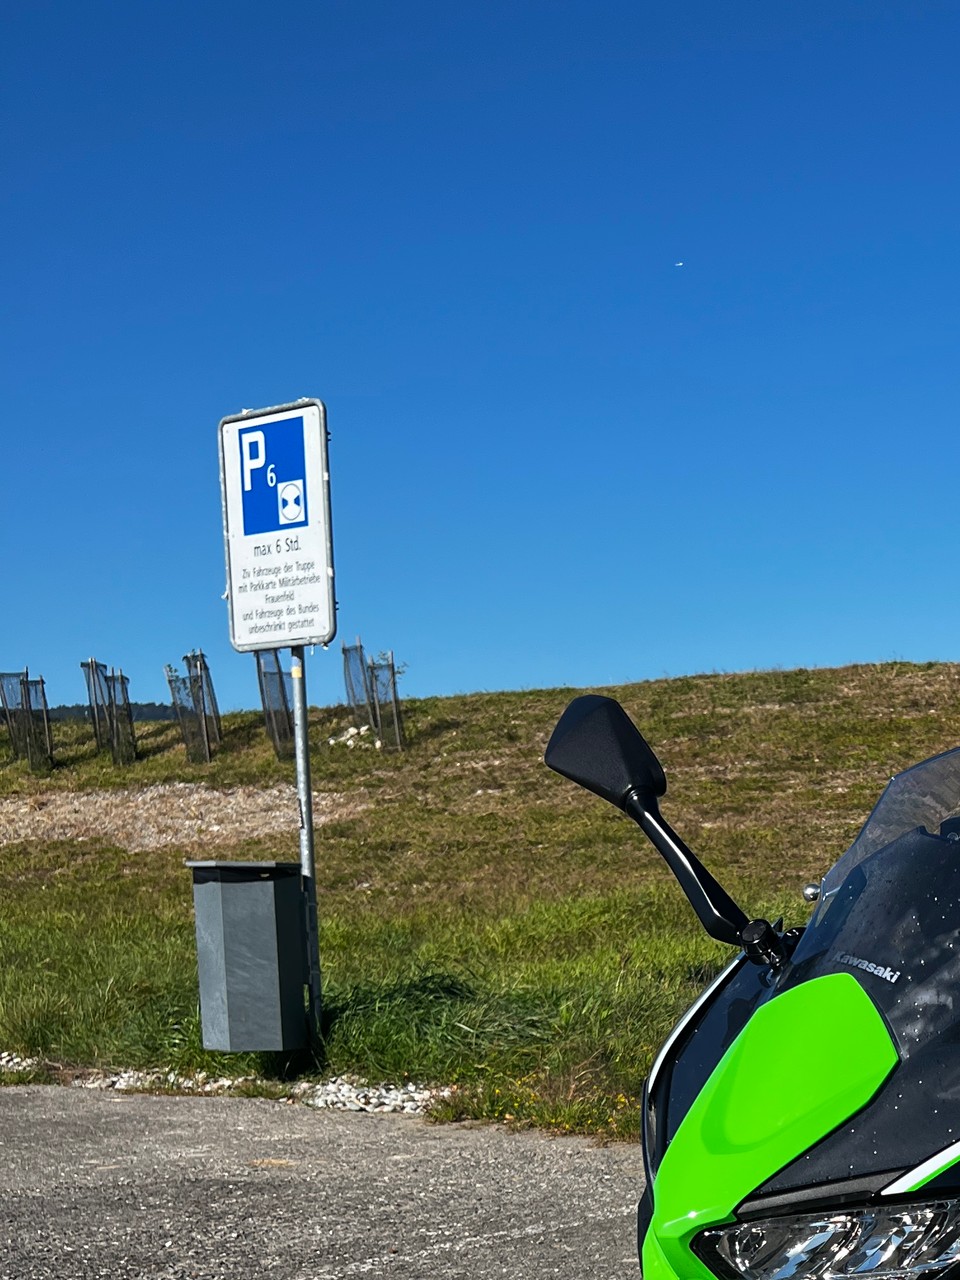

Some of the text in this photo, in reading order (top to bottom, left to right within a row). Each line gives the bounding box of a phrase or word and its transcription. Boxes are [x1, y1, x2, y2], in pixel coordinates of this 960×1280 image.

[241, 430, 266, 492] P
[266, 463, 277, 488] 6
[253, 536, 301, 557] max 6 Std.
[252, 565, 282, 578] Fahrzeuge
[283, 562, 293, 573] der
[295, 560, 315, 574] Truppe
[238, 582, 248, 593] mit
[249, 579, 277, 592] Parkkarte
[265, 590, 295, 604] Frauenfeld
[242, 601, 319, 621] und Fahrzeuge des Bundes
[248, 617, 315, 634] unbeschränkt gestattet
[832, 951, 900, 984] Kawasaki
